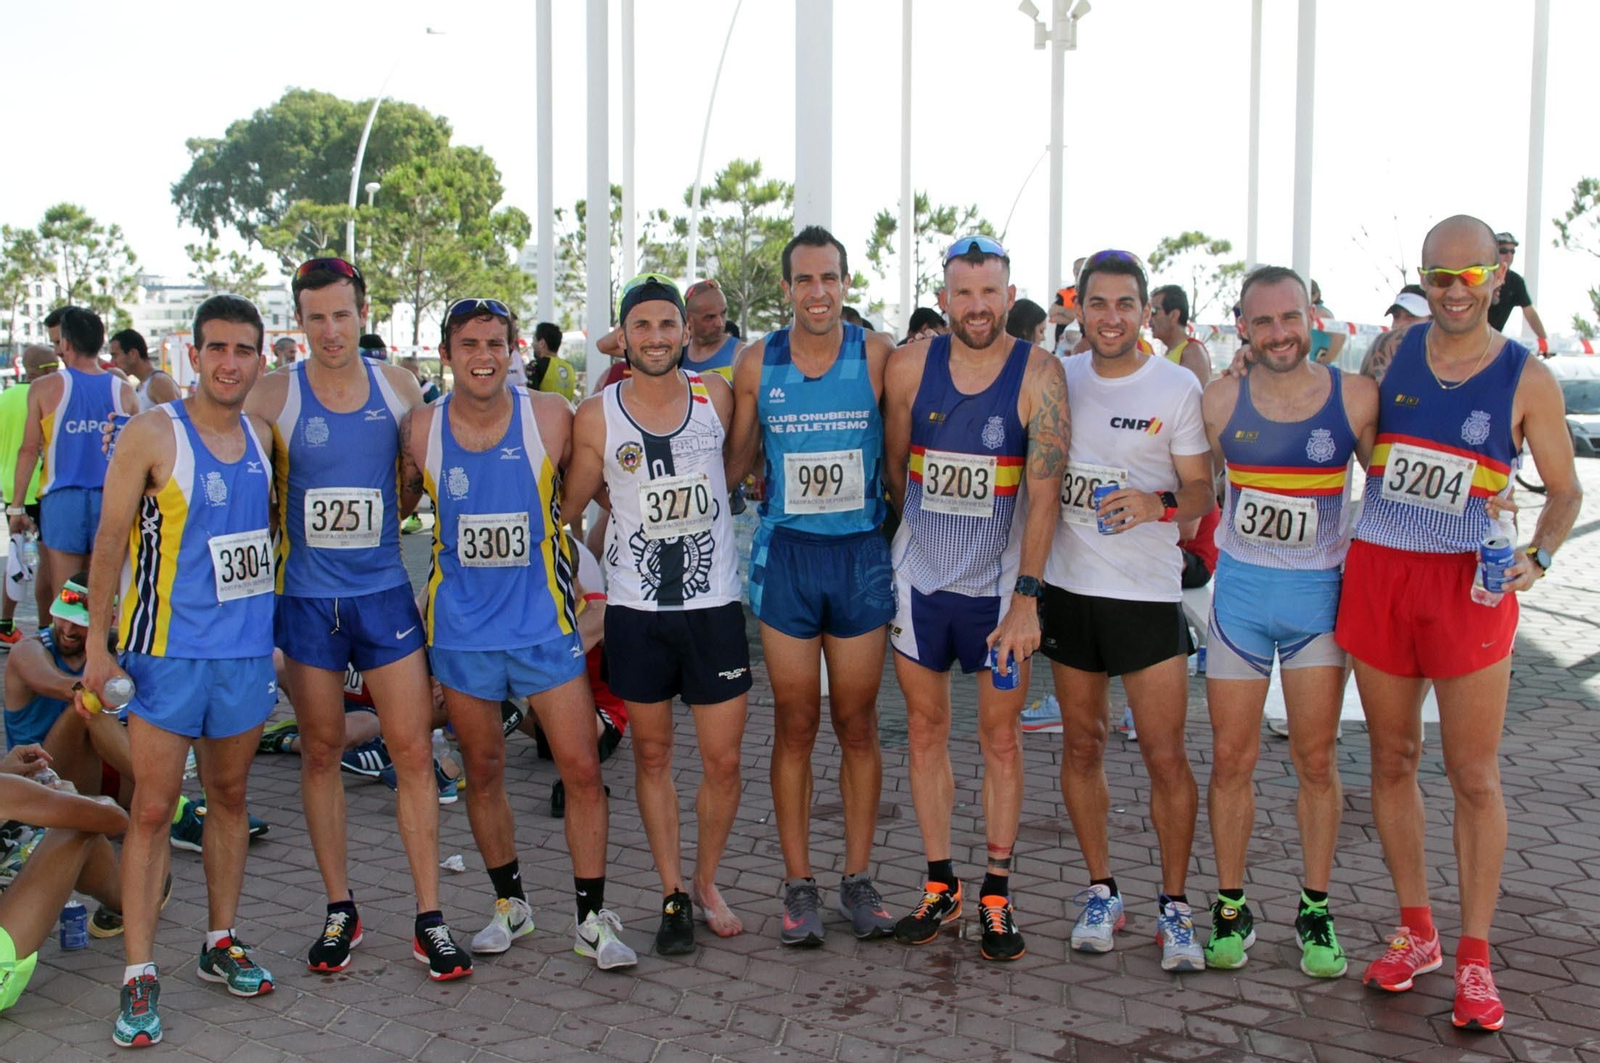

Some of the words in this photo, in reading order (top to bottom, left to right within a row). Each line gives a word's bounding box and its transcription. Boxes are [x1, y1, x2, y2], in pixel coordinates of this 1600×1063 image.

[767, 414, 797, 423] CLUB
[800, 411, 870, 422] ONUBENSE
[785, 421, 868, 434] ATLETISMO
[1110, 417, 1150, 430] CNP
[799, 463, 843, 497] 999
[927, 463, 988, 500] 3203
[1061, 473, 1118, 510] 328
[1389, 458, 1463, 505] 3204
[312, 500, 373, 531] 3251
[647, 484, 708, 523] 3270
[1241, 502, 1307, 541] 3201
[463, 526, 525, 559] 3303
[220, 543, 270, 583] 3304
